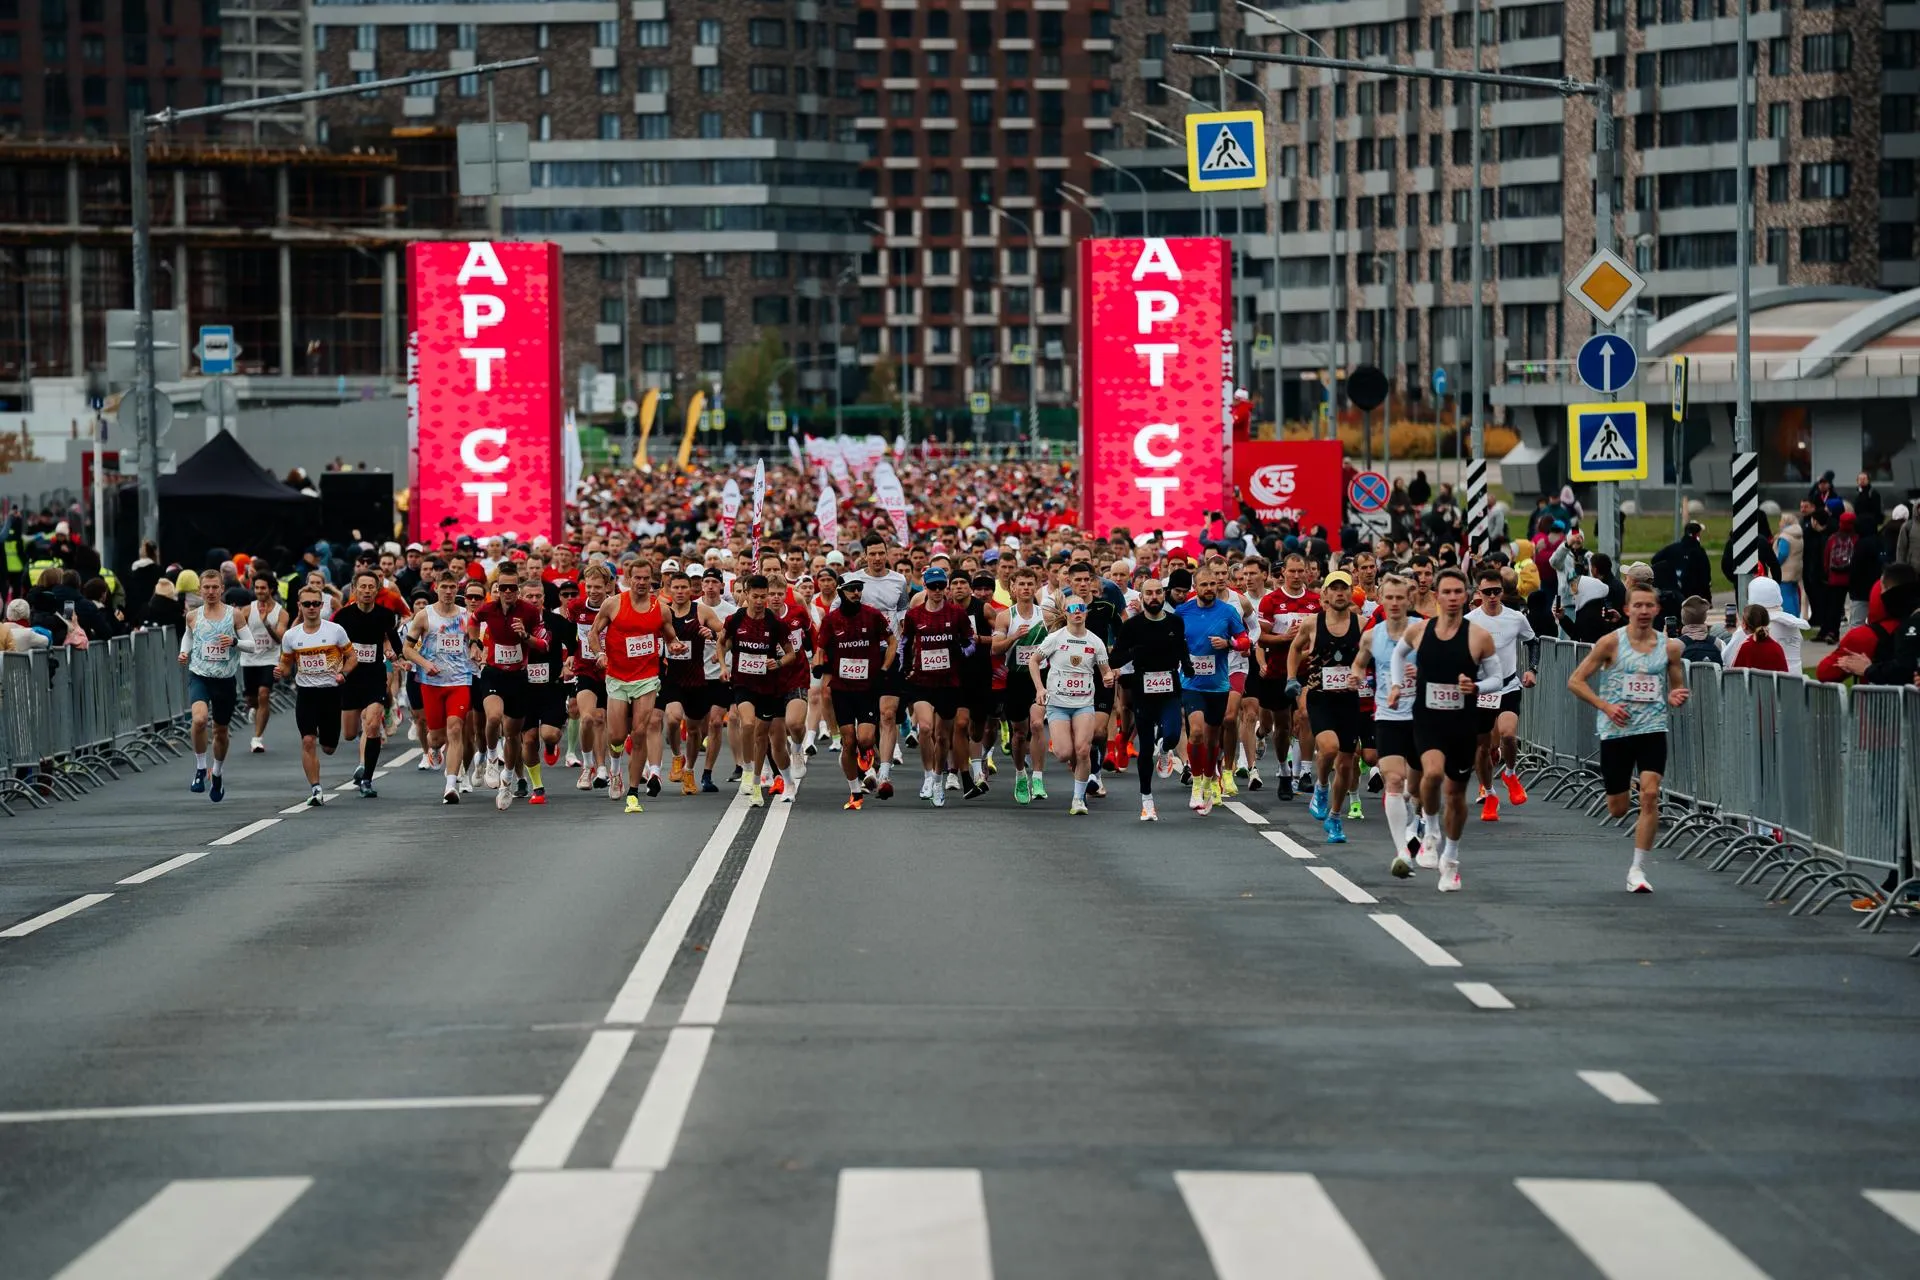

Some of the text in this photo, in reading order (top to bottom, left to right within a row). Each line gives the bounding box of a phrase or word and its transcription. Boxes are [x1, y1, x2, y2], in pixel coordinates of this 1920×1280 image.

[1264, 471, 1296, 495] 35
[441, 639, 461, 648] 1613
[629, 641, 655, 652] 2868
[207, 645, 226, 654] 1715
[500, 650, 518, 659] 1117
[741, 660, 765, 669] 2457
[924, 656, 949, 665] 2405
[303, 661, 325, 670] 1036
[842, 665, 866, 674] 2487
[529, 669, 547, 678] 280
[1066, 680, 1085, 688] 891
[1146, 679, 1172, 688] 2448
[1628, 683, 1656, 693] 1332
[1432, 691, 1461, 701] 1318
[1477, 694, 1500, 703] 537
